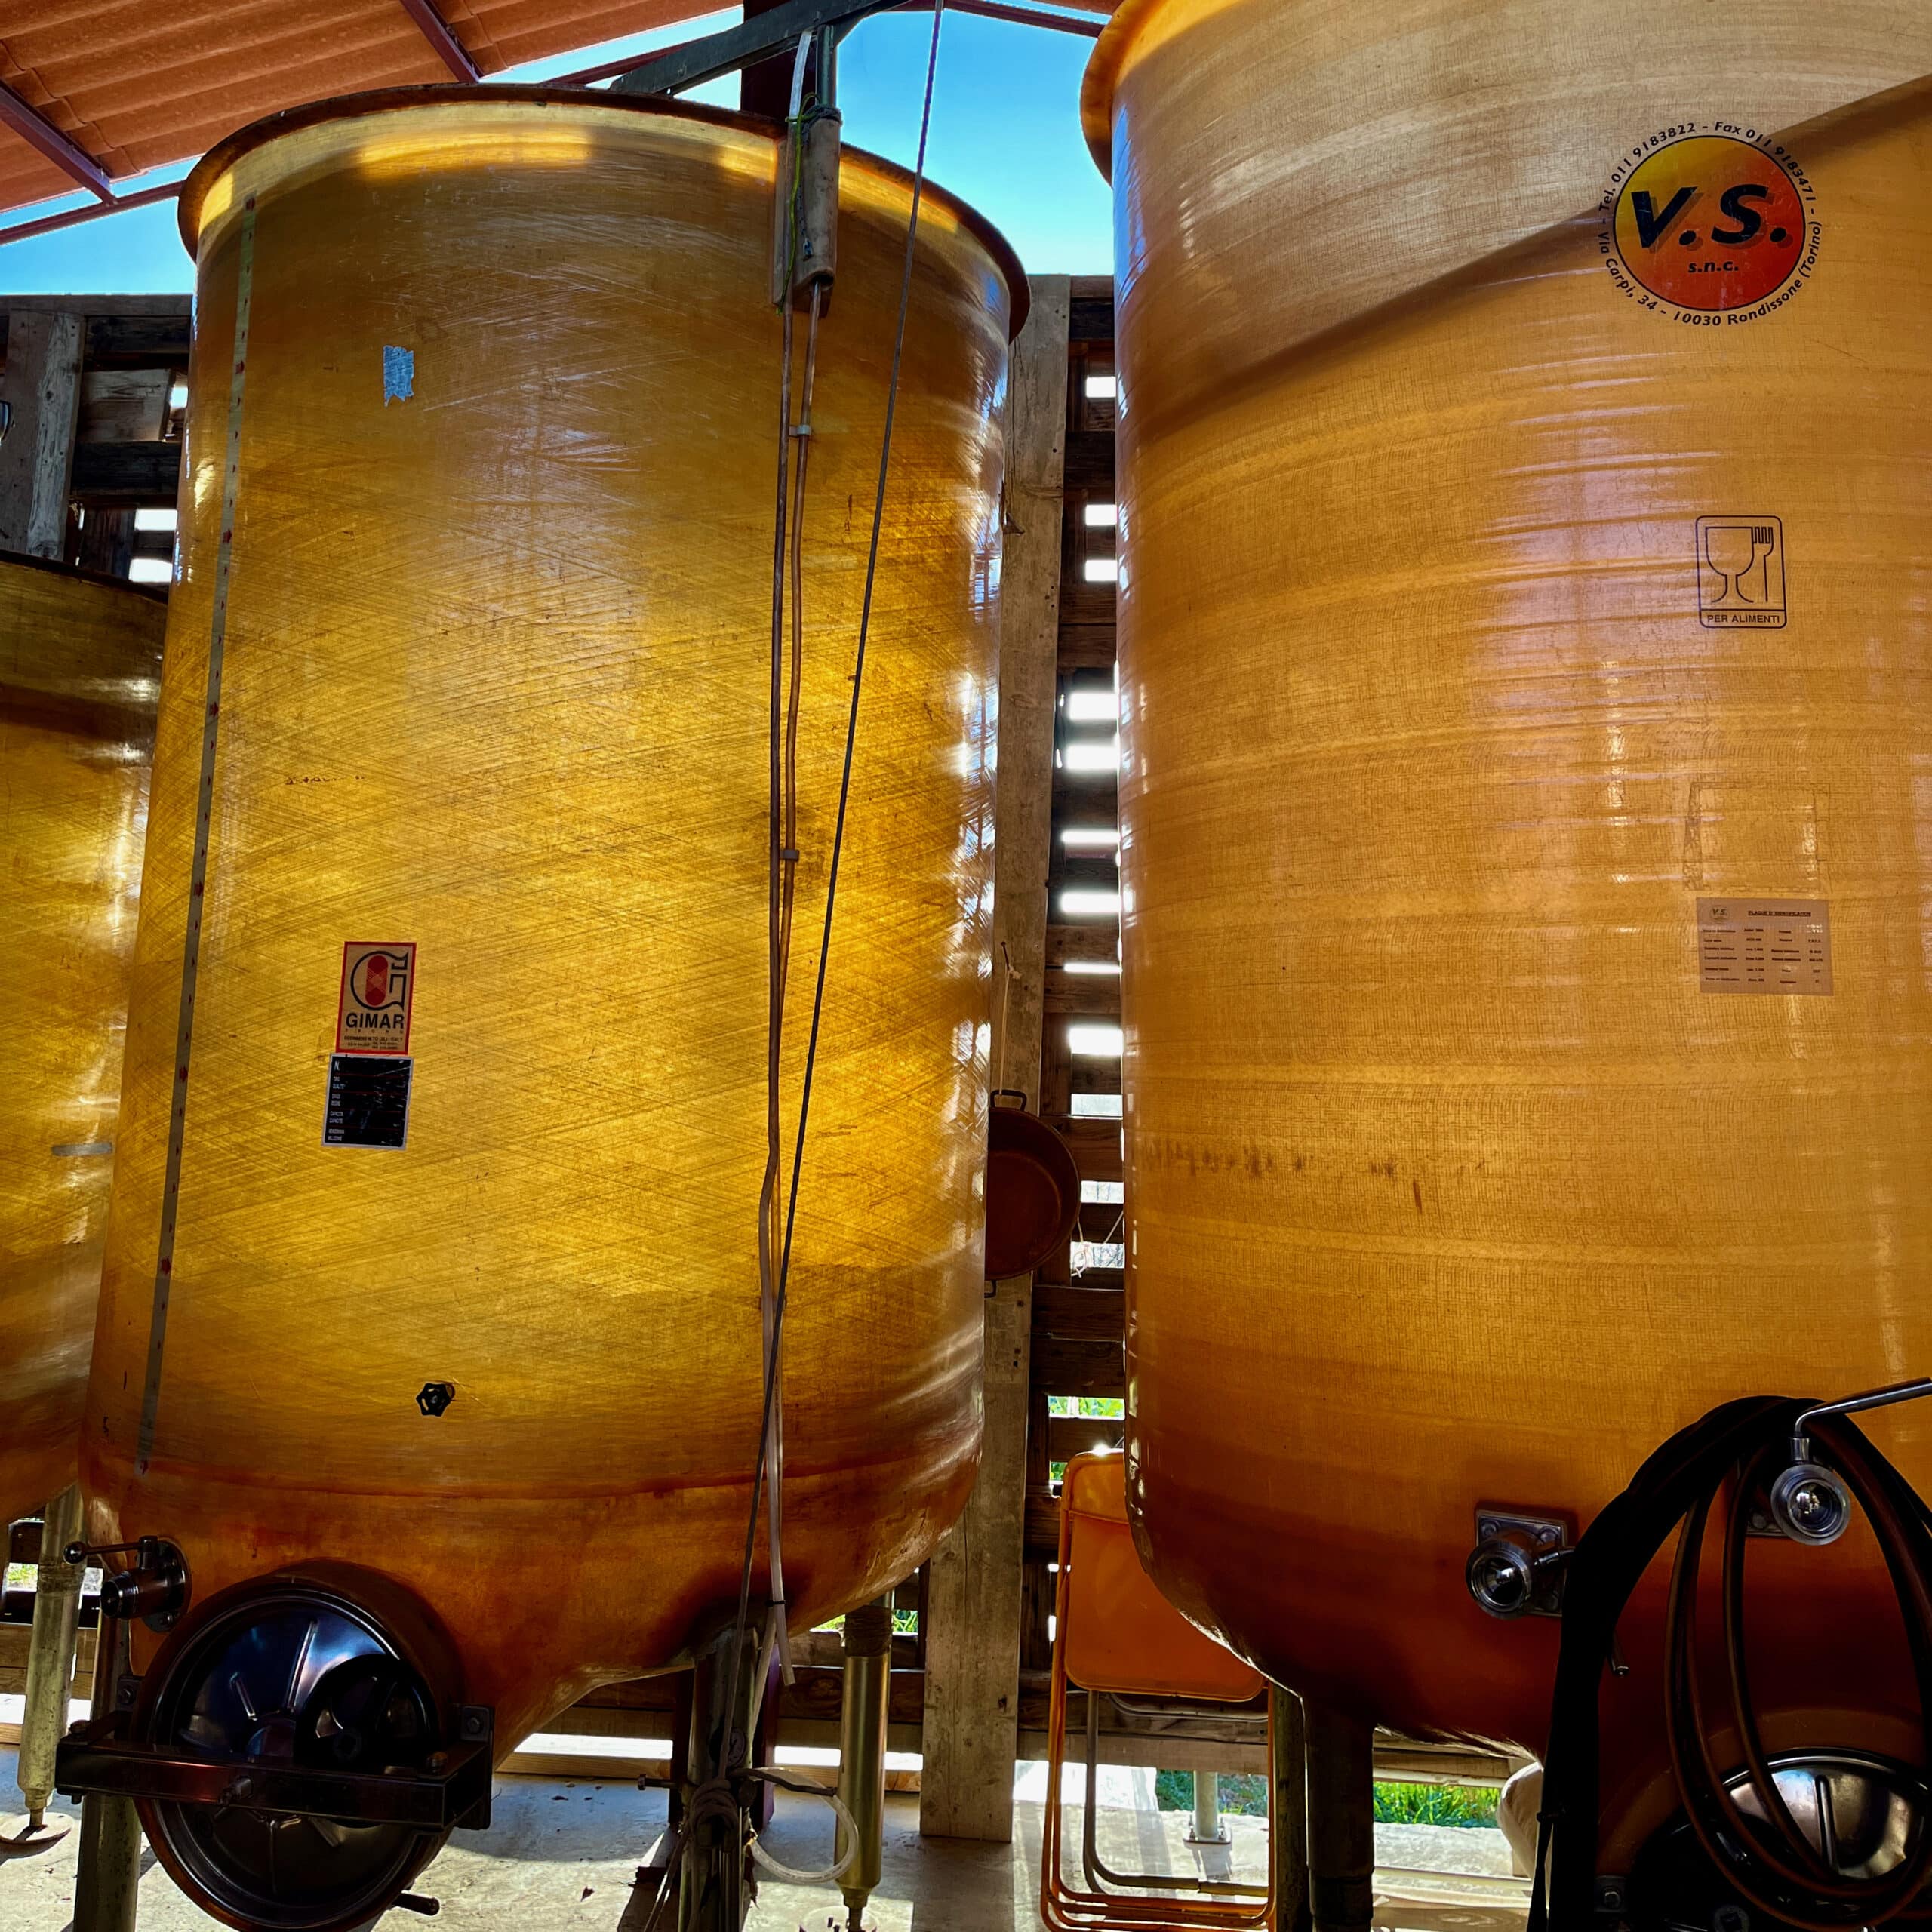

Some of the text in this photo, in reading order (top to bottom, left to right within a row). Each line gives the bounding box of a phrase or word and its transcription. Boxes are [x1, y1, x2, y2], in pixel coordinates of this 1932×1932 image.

[1598, 187, 1616, 211] Tel.
[1611, 158, 1632, 183] 011
[1632, 122, 1696, 158] 9183822
[1714, 121, 1742, 135] Fax
[1746, 129, 1772, 147] 011
[1774, 146, 1817, 201] 9183471
[1631, 183, 1787, 248] V.S.
[1598, 231, 1611, 254] Via
[1605, 258, 1636, 298] Carpi,
[1637, 294, 1658, 310] 34
[1673, 311, 1721, 326] 10030
[1727, 278, 1803, 325] Rondissone
[1798, 221, 1823, 278] (Torino)
[1687, 260, 1739, 273] s.n.c.
[1707, 614, 1780, 623] PER ALIMENTI
[345, 1013, 405, 1029] GIMAR
